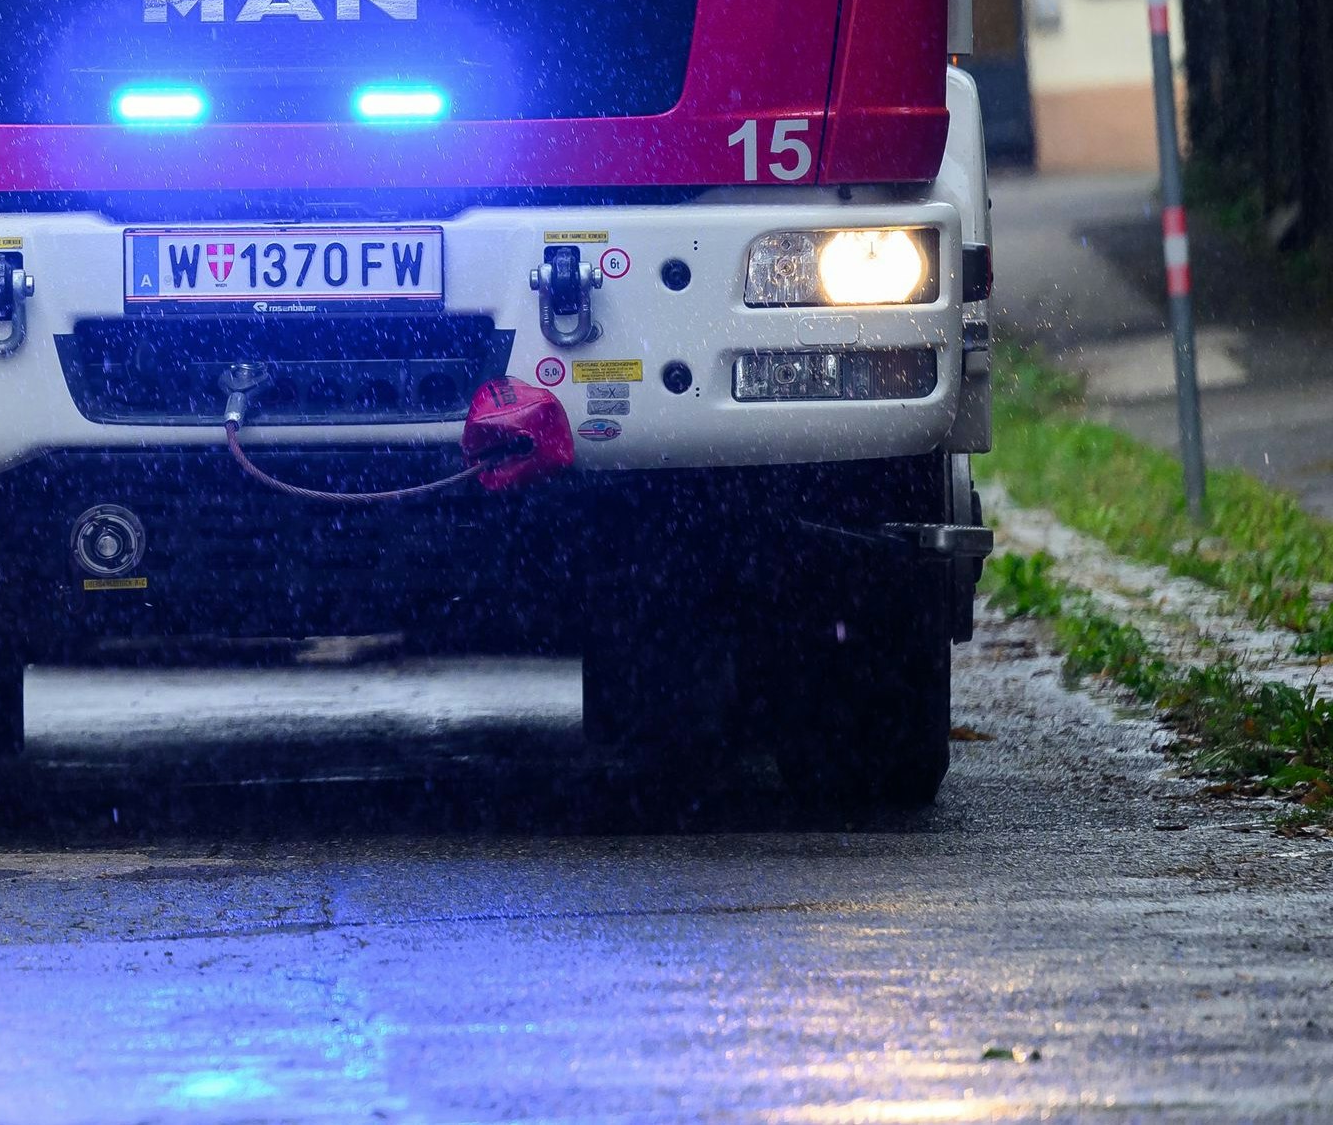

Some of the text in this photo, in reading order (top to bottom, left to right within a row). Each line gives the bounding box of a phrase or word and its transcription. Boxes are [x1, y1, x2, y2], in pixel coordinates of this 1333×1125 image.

[727, 118, 812, 182] 15
[168, 243, 201, 289] W
[610, 257, 620, 270] 6t
[140, 274, 153, 288] A
[269, 304, 317, 313] rosenbauer
